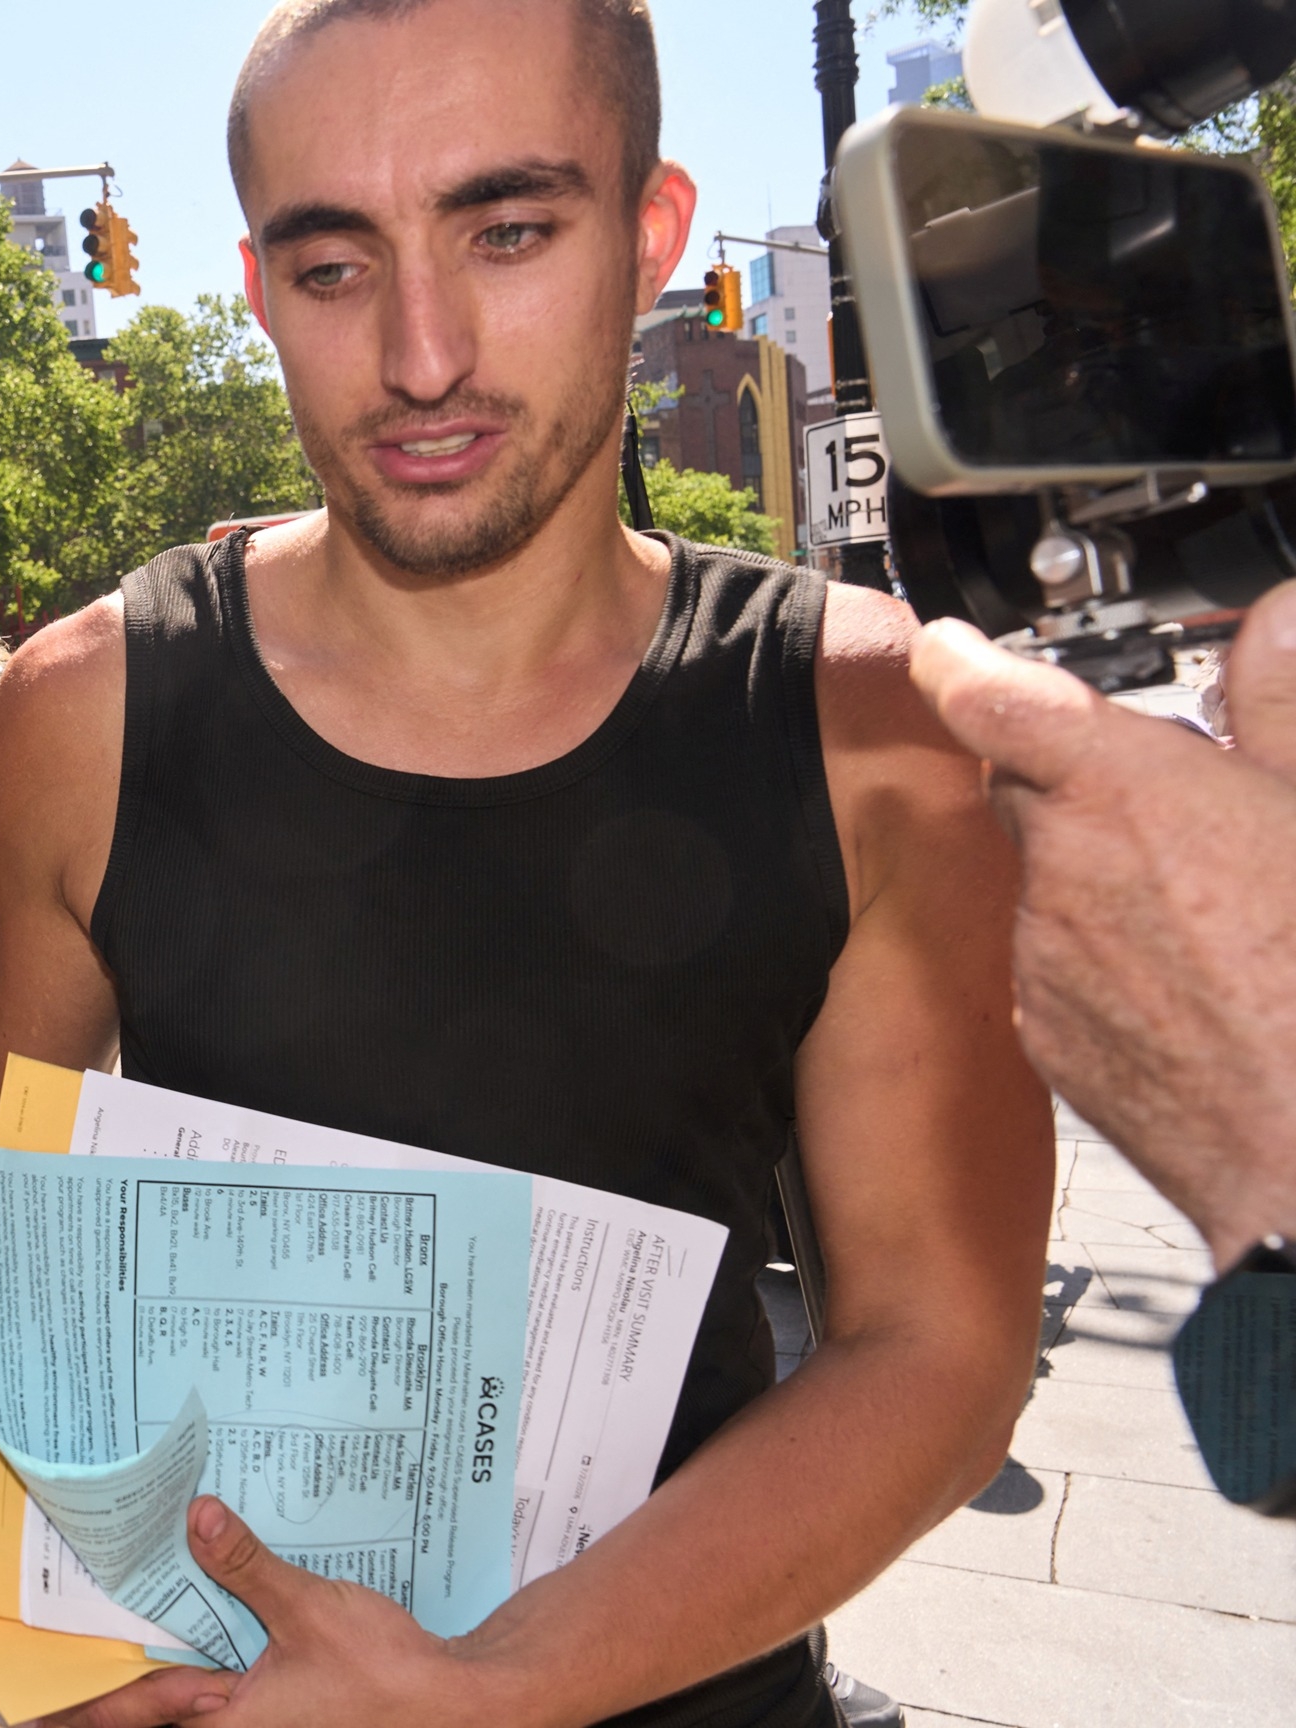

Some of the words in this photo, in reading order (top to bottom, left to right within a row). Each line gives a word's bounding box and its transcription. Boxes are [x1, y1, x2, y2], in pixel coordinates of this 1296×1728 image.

[825, 434, 886, 492] 15
[828, 496, 886, 530] MPH
[92, 1107, 104, 1140] Angelina
[174, 1127, 185, 1157] General
[120, 1179, 128, 1204] Your
[182, 1187, 192, 1212] Buses
[205, 1188, 212, 1196] to
[260, 1191, 270, 1216] Trains
[318, 1193, 328, 1219] Office
[204, 1198, 213, 1222] Brook
[380, 1196, 390, 1230] Contact
[392, 1196, 402, 1231] Borough
[569, 1216, 580, 1230] This
[318, 1220, 327, 1256] Address
[380, 1232, 389, 1244] Us
[541, 1209, 556, 1243] Continue
[555, 1212, 568, 1238] further
[119, 1206, 128, 1291] Responsibilities
[393, 1233, 402, 1266] Director
[421, 1234, 430, 1266] Bronx
[468, 1236, 478, 1253] You
[543, 1238, 560, 1280] emergency
[562, 1231, 574, 1258] patient
[571, 1218, 600, 1292] Instructions
[629, 1231, 646, 1273] Angelina
[645, 1234, 666, 1275] AFTER
[468, 1255, 477, 1277] have
[531, 1243, 547, 1288] medications
[559, 1258, 569, 1272] has
[105, 1280, 111, 1289] to
[467, 1278, 476, 1301] been
[527, 1289, 536, 1298] as
[538, 1280, 550, 1310] medical
[555, 1273, 565, 1292] been
[619, 1276, 636, 1313] Nikolau
[637, 1279, 655, 1309] VISIT
[104, 1290, 112, 1324] respect
[437, 1282, 448, 1322] Borough
[545, 1293, 559, 1329] evaluated
[270, 1311, 280, 1337] Trains
[320, 1313, 330, 1340] Office
[346, 1315, 355, 1339] Team
[382, 1316, 392, 1351] Contact
[437, 1324, 447, 1353] Office
[452, 1316, 461, 1345] Please
[464, 1302, 474, 1348] mandated
[526, 1310, 543, 1359] management
[541, 1329, 550, 1345] and
[319, 1341, 329, 1377] Address
[382, 1353, 390, 1364] Us
[462, 1349, 473, 1360] by
[535, 1345, 547, 1373] cleared
[619, 1313, 646, 1381] SUMMARY
[415, 1345, 427, 1391] Brooklyn
[449, 1347, 458, 1384] proceed
[521, 1369, 529, 1382] the
[524, 1359, 531, 1368] at
[449, 1385, 457, 1395] to
[461, 1362, 472, 1408] Manhattan
[528, 1385, 537, 1400] any
[532, 1373, 542, 1385] for
[108, 1392, 116, 1418] office
[431, 1387, 444, 1424] Monday
[447, 1396, 455, 1416] your
[520, 1400, 534, 1436] condition
[459, 1409, 467, 1432] court
[264, 1431, 274, 1458] Trains
[314, 1433, 324, 1461] Office
[372, 1433, 384, 1467] Contact
[443, 1417, 454, 1455] assigned
[457, 1434, 466, 1443] to
[472, 1403, 497, 1483] CASES
[454, 1444, 465, 1474] CASES
[313, 1462, 323, 1498] Address
[370, 1468, 380, 1480] Us
[406, 1463, 419, 1500] Harlem
[426, 1466, 436, 1489] 9:00
[438, 1456, 451, 1493] borough
[425, 1490, 434, 1506] AM
[450, 1476, 462, 1523] Supervised
[422, 1514, 432, 1537] 5:00
[421, 1538, 430, 1554] PM
[447, 1524, 458, 1558] Release
